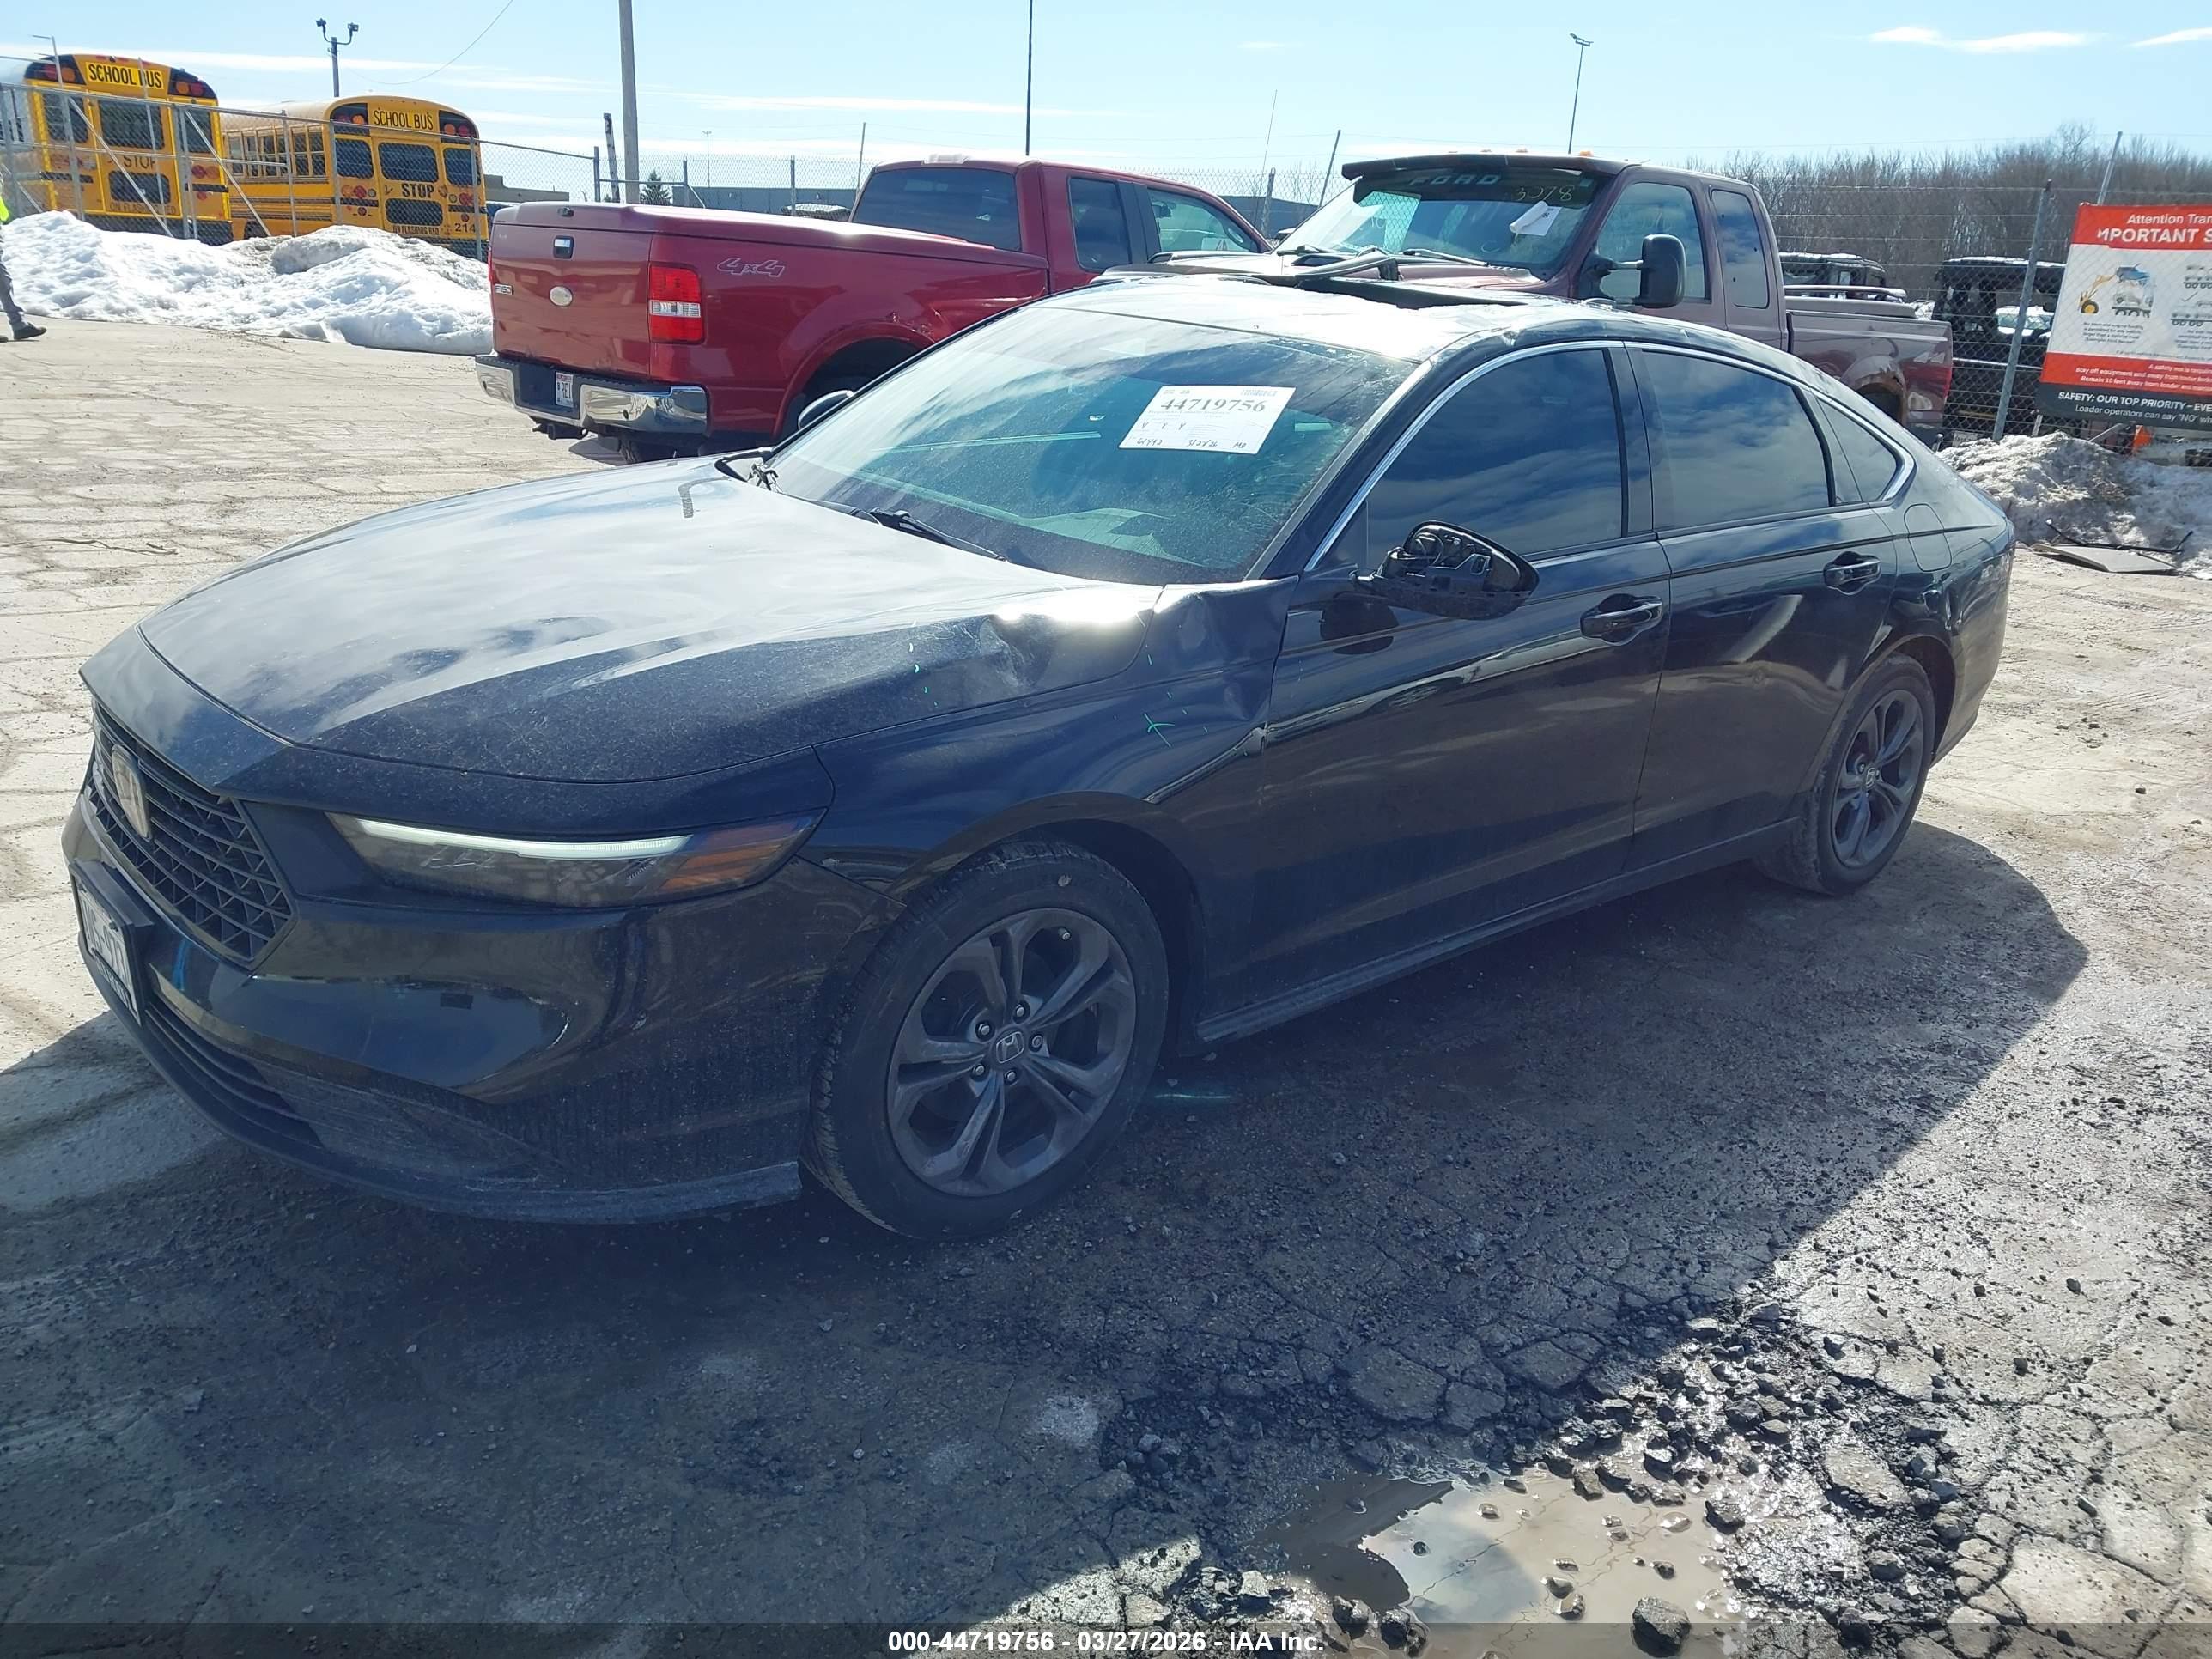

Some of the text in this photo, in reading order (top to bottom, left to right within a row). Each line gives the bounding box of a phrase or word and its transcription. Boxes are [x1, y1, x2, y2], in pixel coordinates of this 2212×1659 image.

[88, 64, 137, 85] SCHOOL
[374, 110, 434, 130] SCHOOL BUS
[1409, 174, 1500, 185] FORD
[401, 183, 434, 198] STOP
[2127, 214, 2185, 224] Attention
[1160, 398, 1268, 413] 44719756
[2058, 392, 2095, 402] SAFETY:
[2096, 395, 2118, 404] OUR
[2120, 397, 2140, 406] TOP
[2141, 398, 2186, 410] PRIORITY
[2075, 404, 2103, 414] Loader
[2104, 407, 2142, 418] operators
